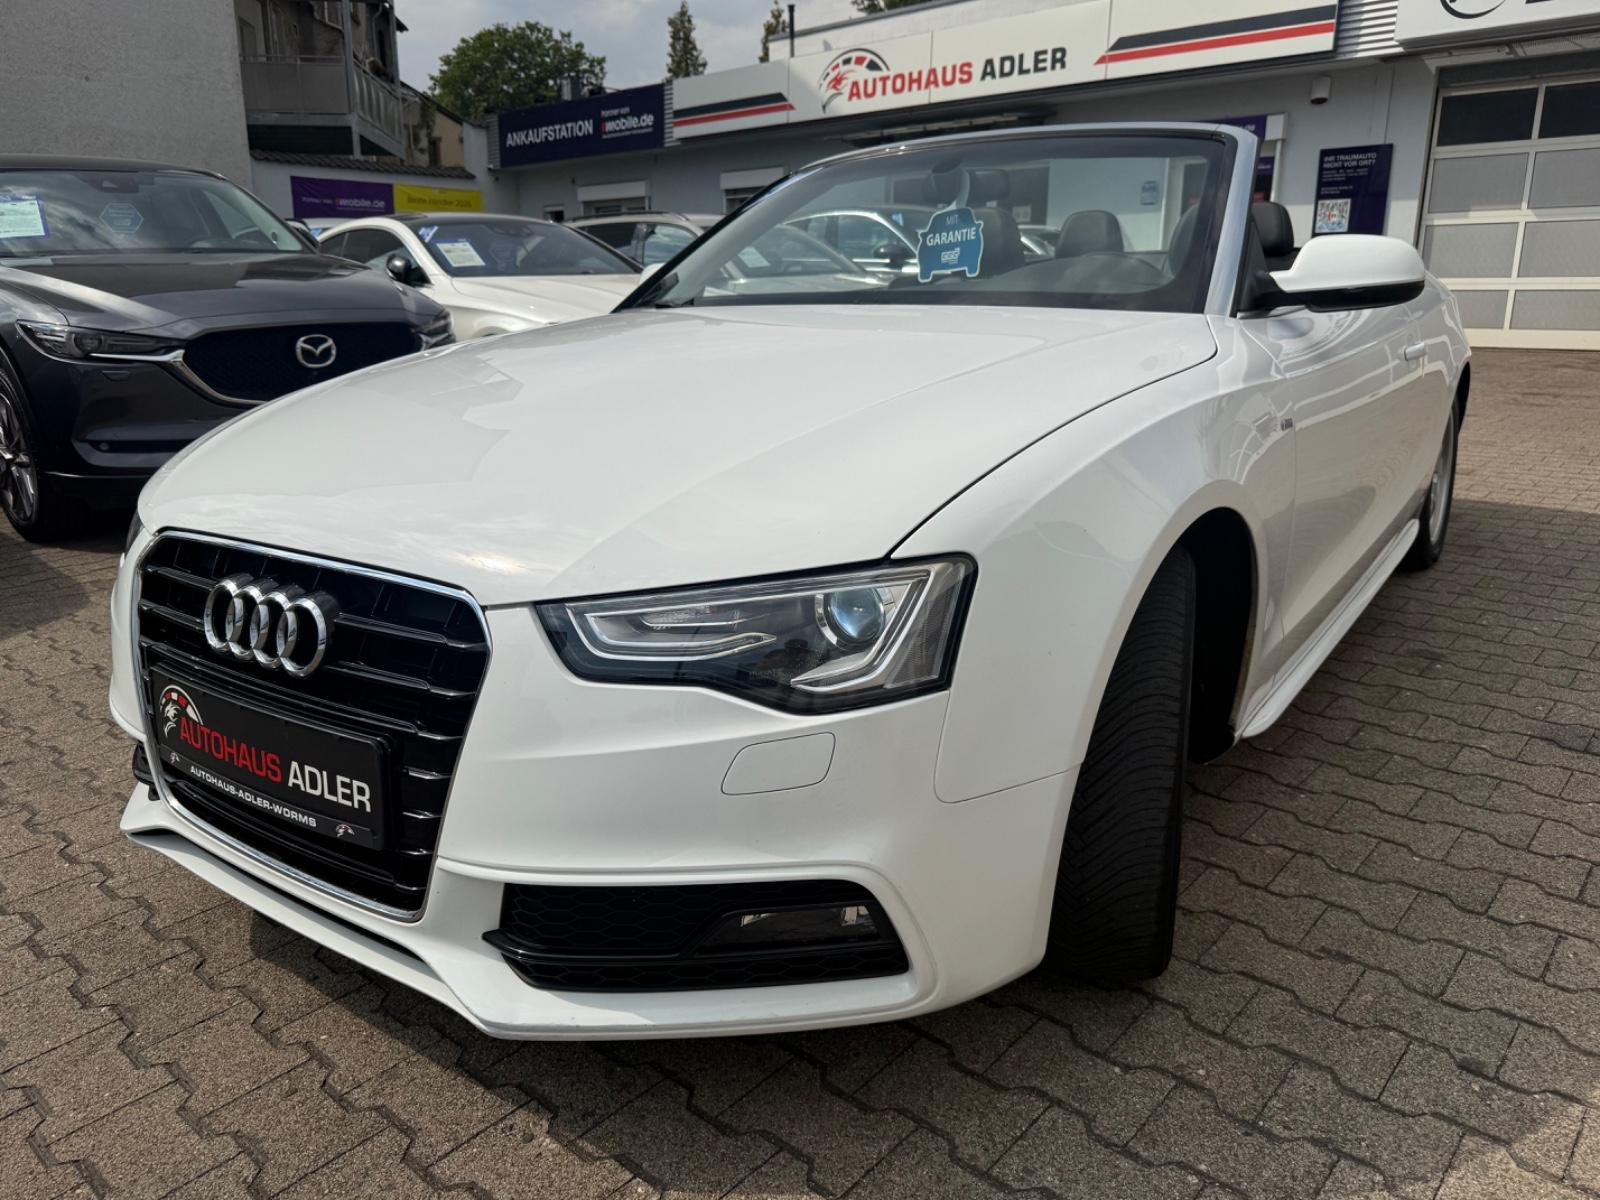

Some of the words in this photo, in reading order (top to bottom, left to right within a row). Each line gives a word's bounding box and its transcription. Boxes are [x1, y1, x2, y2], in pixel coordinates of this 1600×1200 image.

[847, 62, 973, 101] AUTOHAUS
[980, 47, 1067, 81] ADLER
[506, 119, 594, 148] ANKAUFSTATION
[602, 114, 654, 132] mobile.de
[946, 214, 959, 225] MIT
[926, 227, 977, 247] GARANTIE
[179, 716, 282, 784] AUTOHAUS
[287, 760, 372, 813] ADLER
[189, 765, 317, 828] AUTOHAUS-ADLER-WORMS
